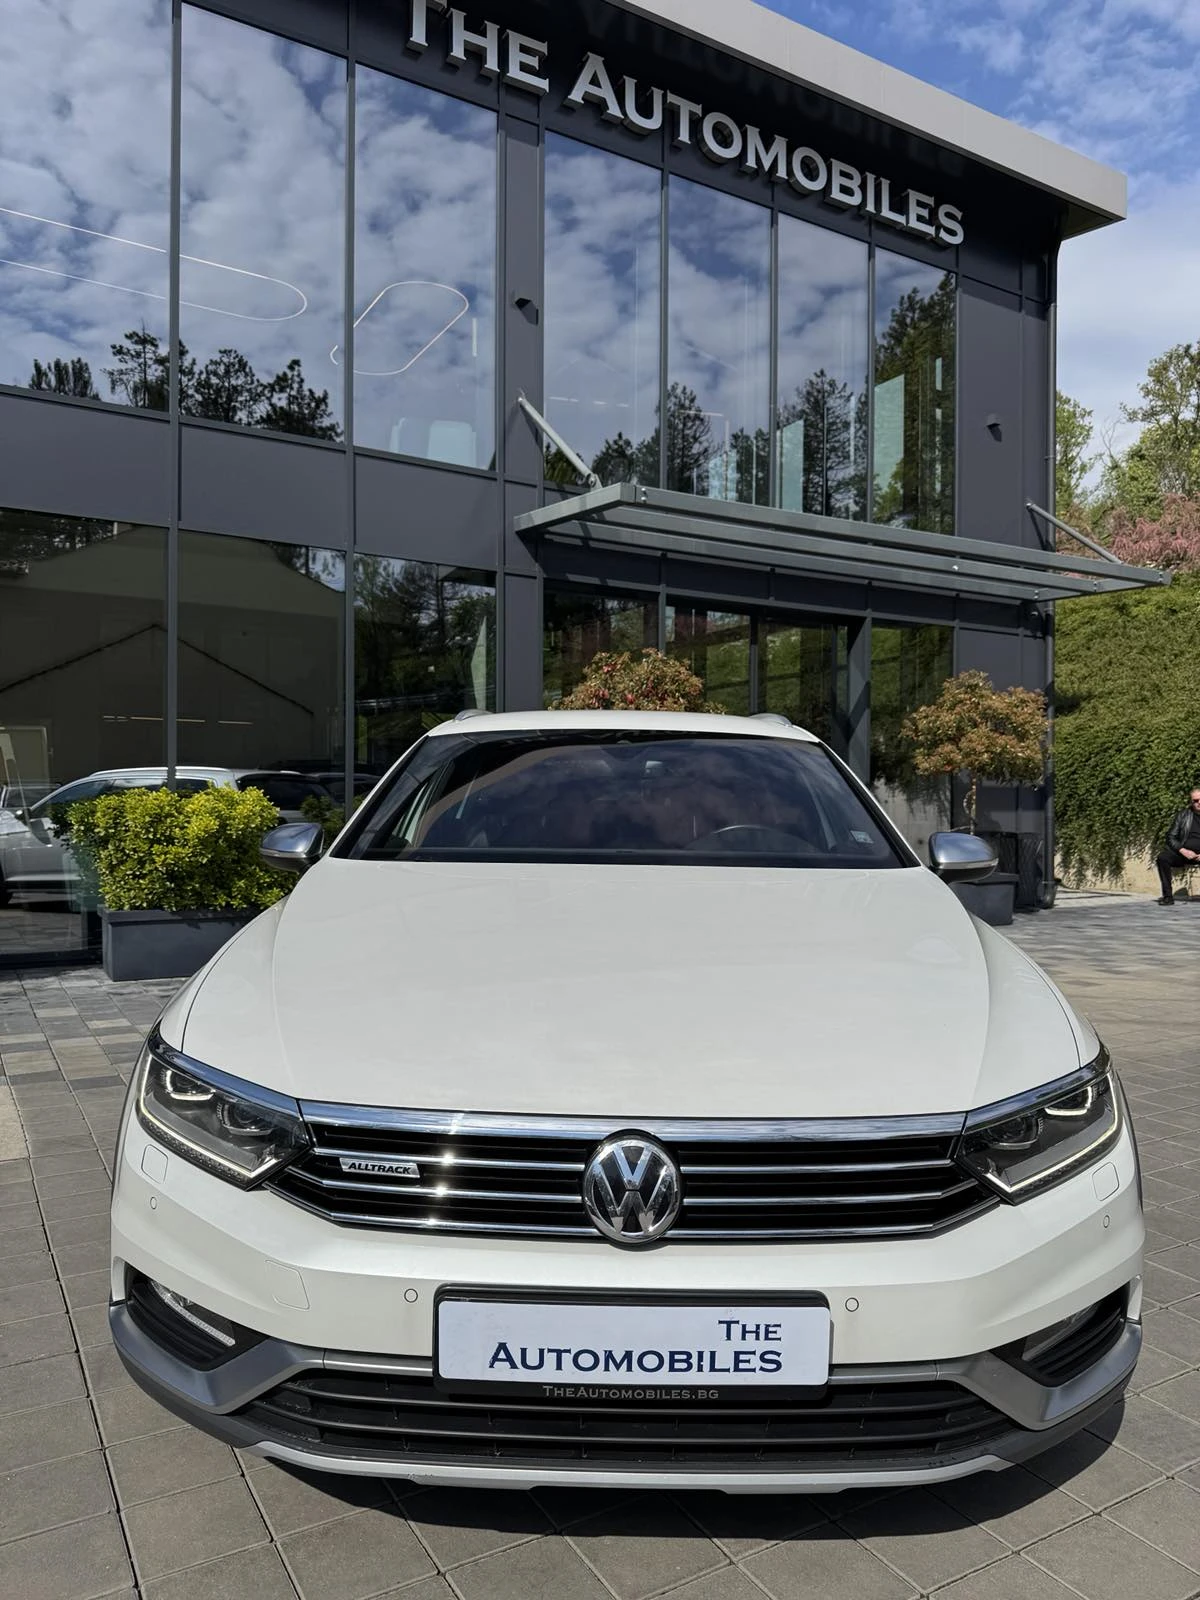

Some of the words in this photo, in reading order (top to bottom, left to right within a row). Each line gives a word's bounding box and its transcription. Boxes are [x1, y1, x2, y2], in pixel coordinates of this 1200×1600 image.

[408, 0, 550, 93] THE
[567, 51, 965, 246] AUTOMOBILES
[347, 1161, 412, 1175] ALLTRACK
[717, 1319, 783, 1342] THE
[487, 1341, 783, 1374] AUTOMOBILES
